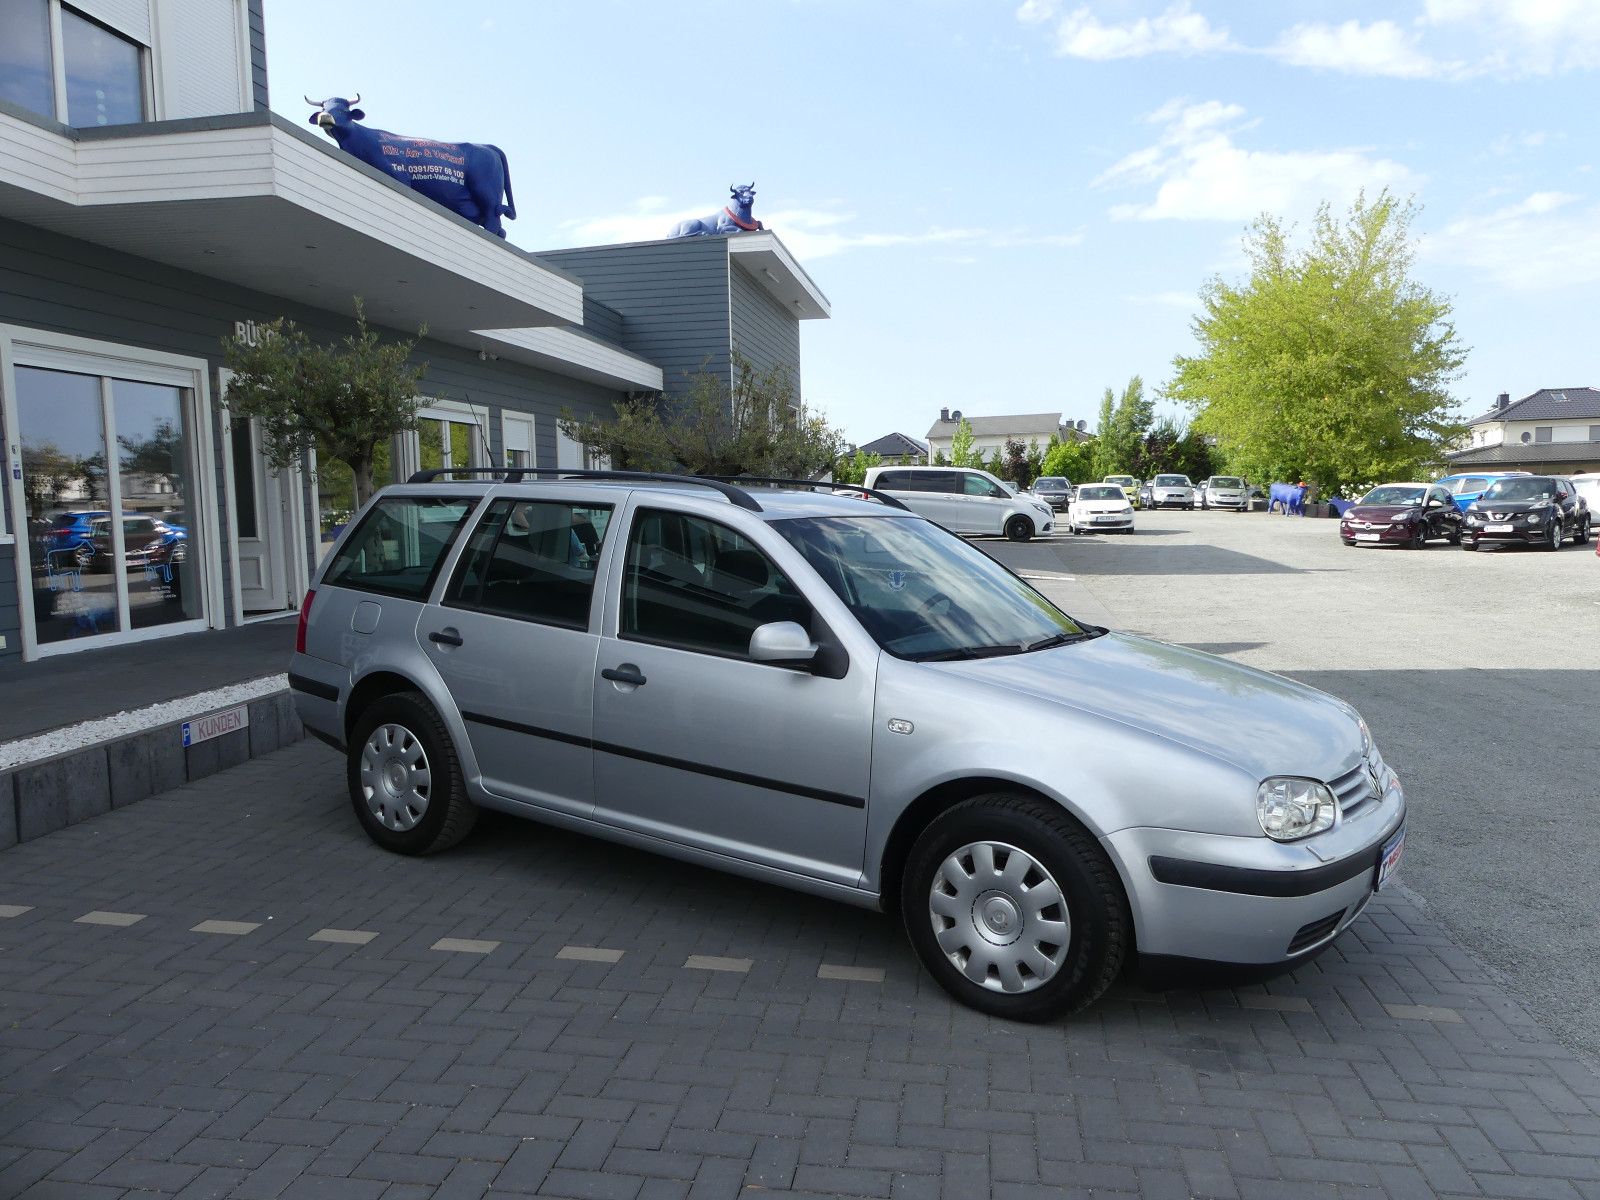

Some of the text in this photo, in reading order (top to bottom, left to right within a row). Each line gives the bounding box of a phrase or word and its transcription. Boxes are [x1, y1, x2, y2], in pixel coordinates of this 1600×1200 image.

[391, 163, 407, 172] Tel.
[408, 165, 443, 173] 0391/597
[198, 710, 242, 739] KUNDEN
